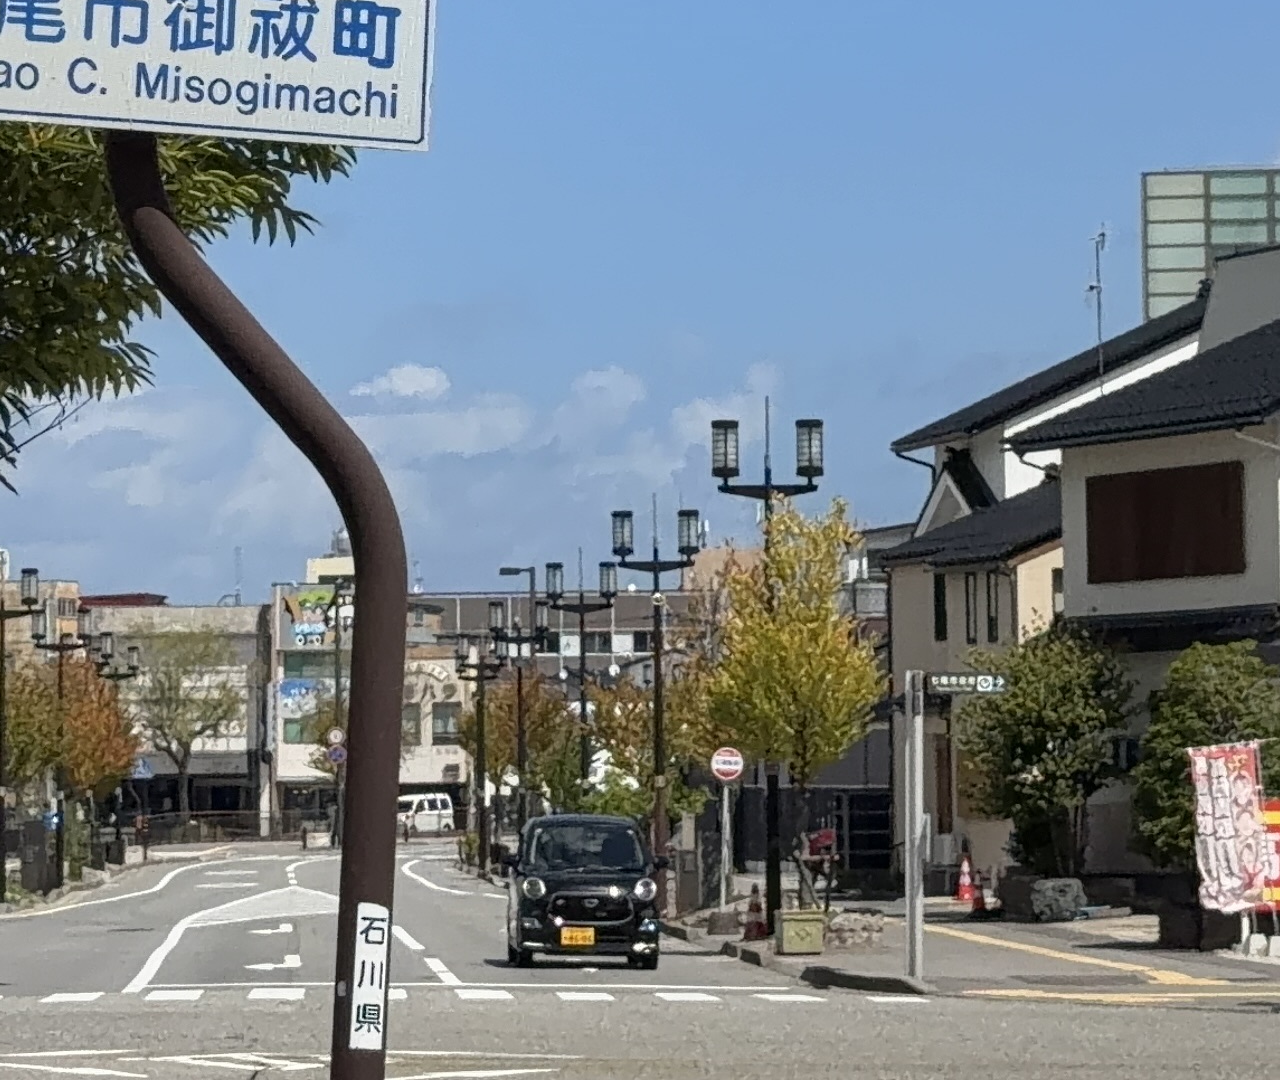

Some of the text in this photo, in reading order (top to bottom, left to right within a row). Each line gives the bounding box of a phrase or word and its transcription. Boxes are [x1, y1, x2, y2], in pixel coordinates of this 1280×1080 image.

[67, 56, 108, 96] C.
[135, 62, 399, 120] Misogimachi
[353, 916, 388, 1034] 石川県
